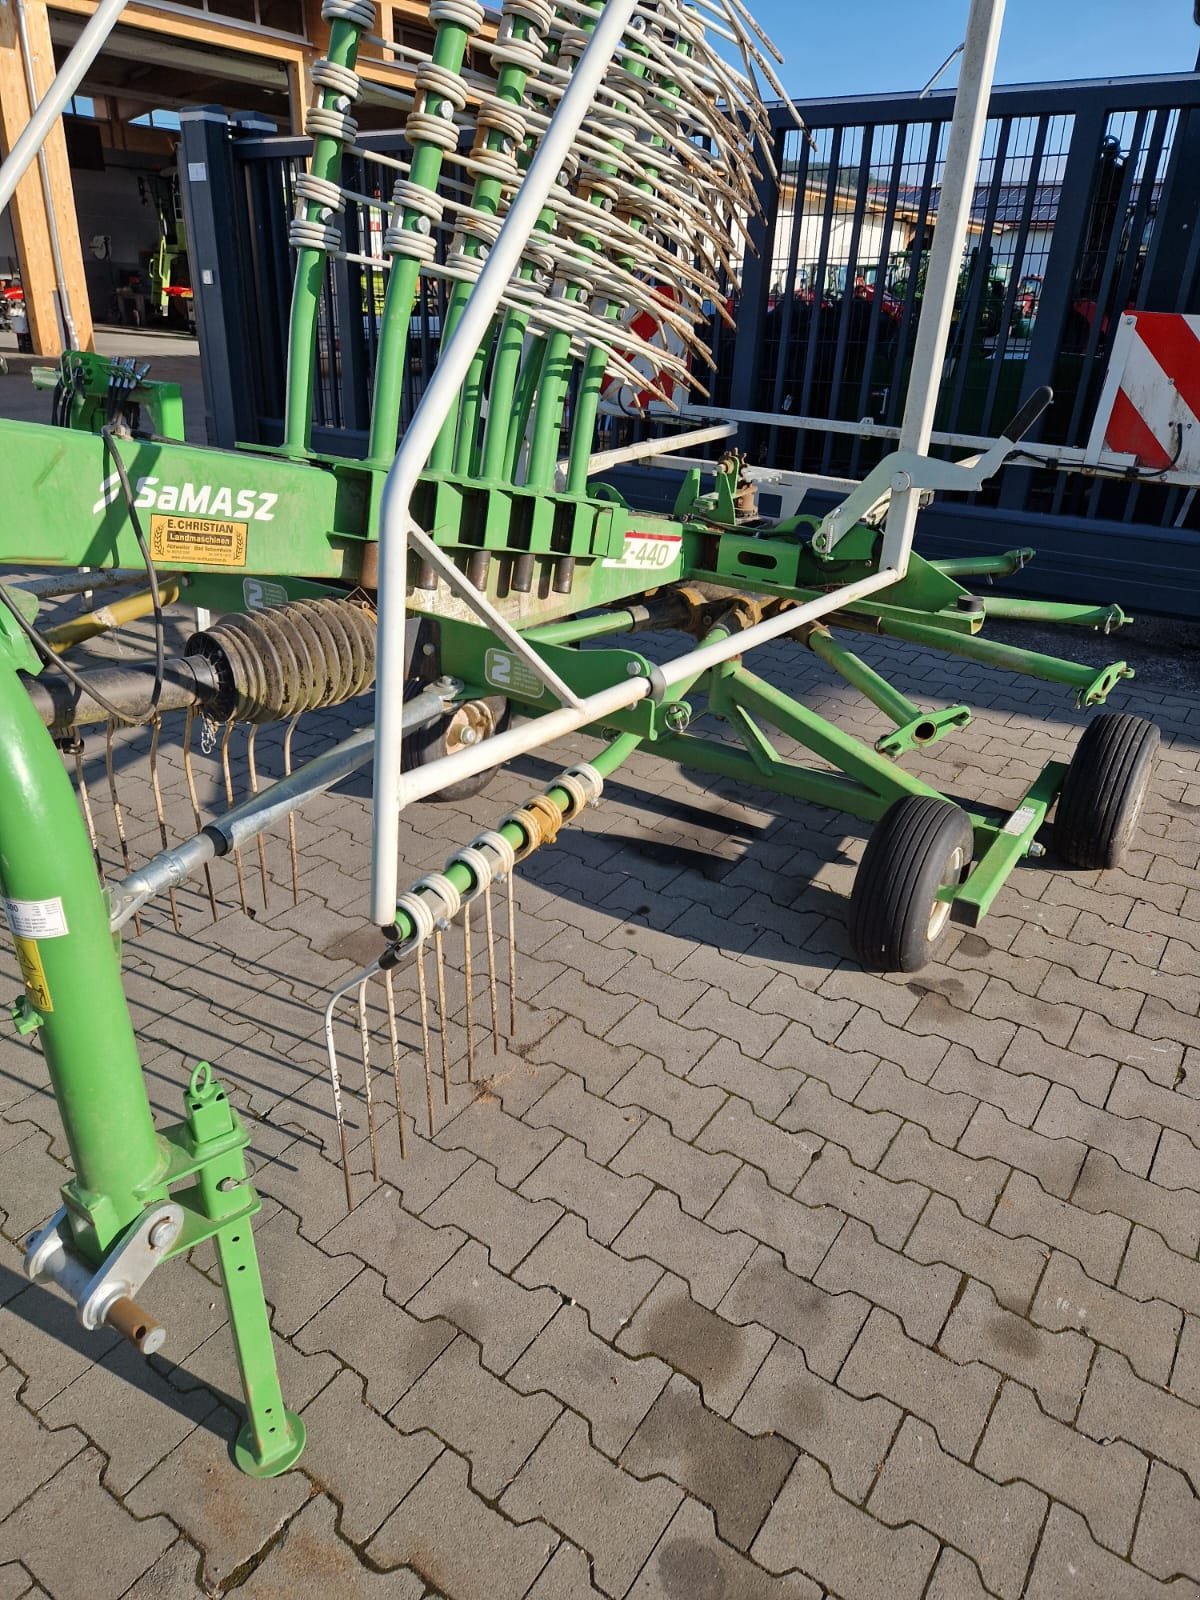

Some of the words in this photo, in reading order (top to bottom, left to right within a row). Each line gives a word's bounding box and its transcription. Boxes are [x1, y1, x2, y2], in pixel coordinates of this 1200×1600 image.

[134, 476, 279, 521] SaMASZ
[169, 532, 230, 545] Landmaschinen
[248, 583, 263, 608] 2
[492, 654, 511, 684] 2
